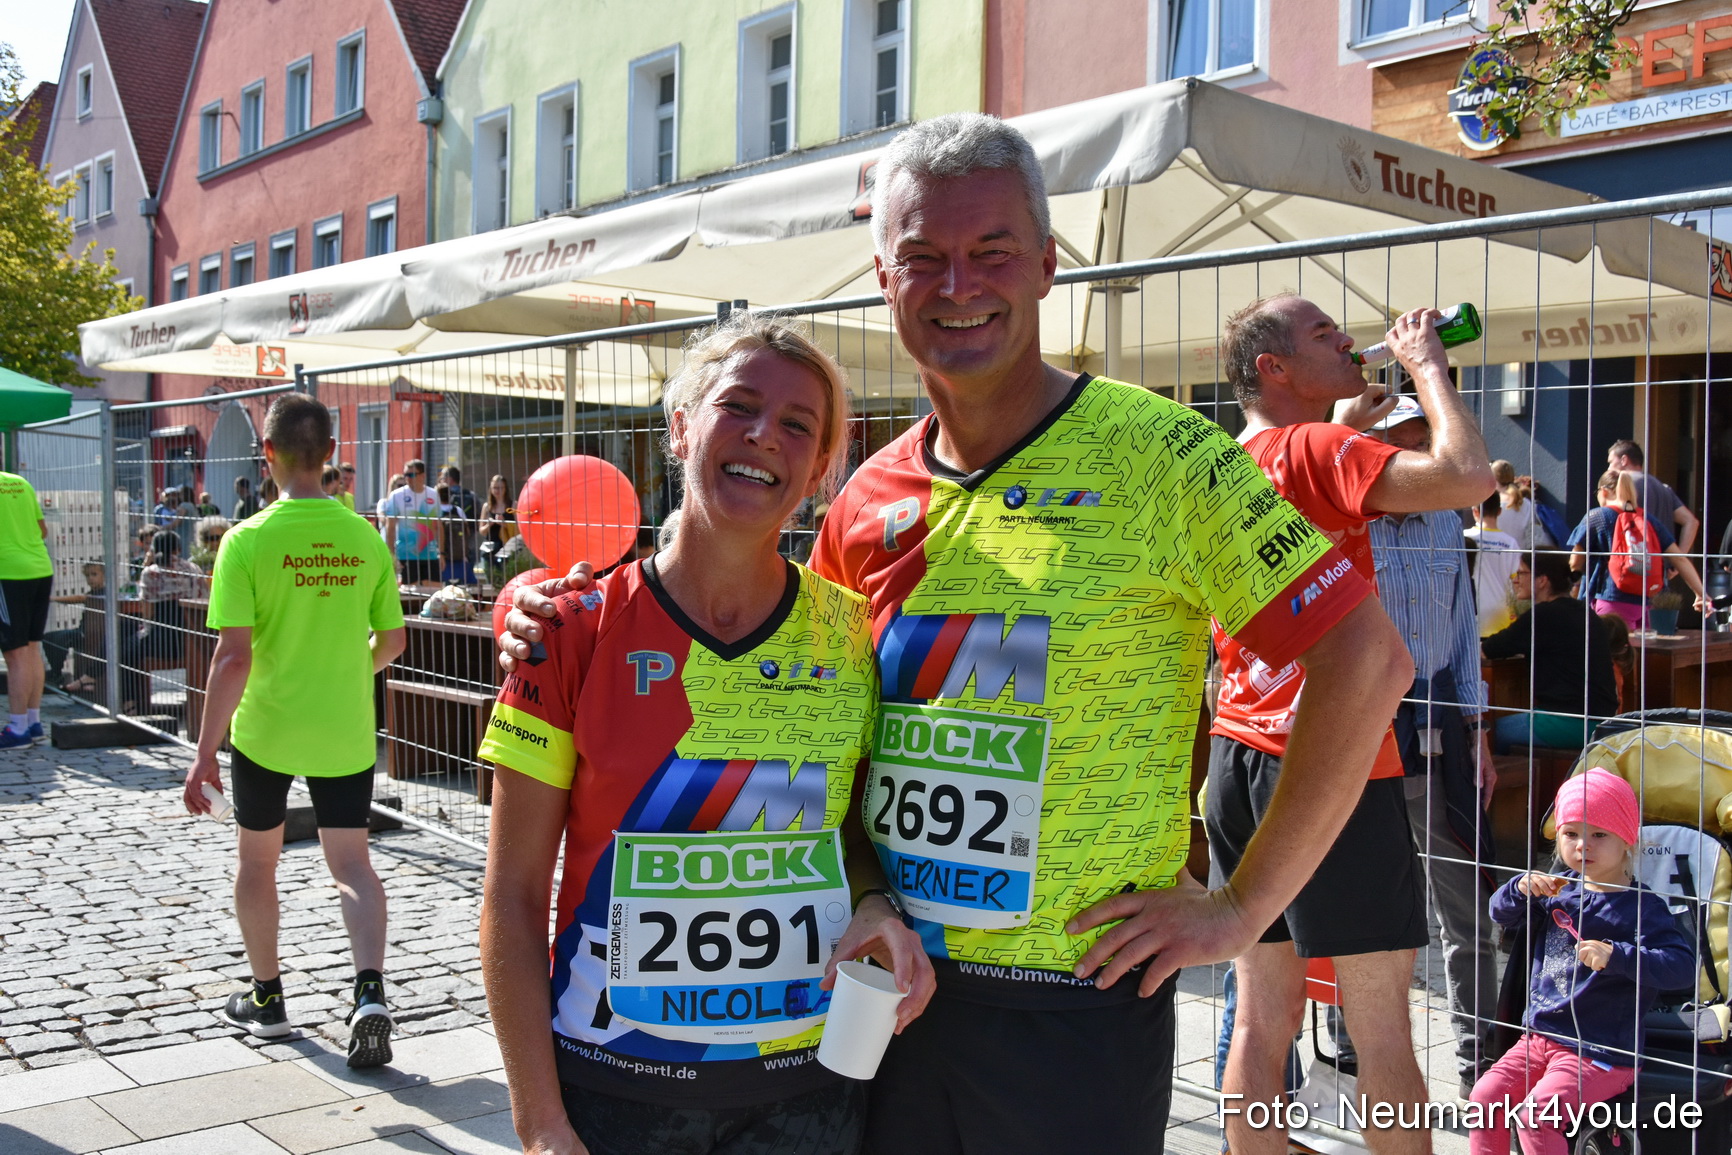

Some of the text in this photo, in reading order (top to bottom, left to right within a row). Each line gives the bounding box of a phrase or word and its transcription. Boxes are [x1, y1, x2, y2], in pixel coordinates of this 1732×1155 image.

[1373, 150, 1496, 218] Tucher
[499, 238, 596, 281] Tucher
[130, 322, 176, 349] Tucher
[1000, 515, 1077, 524] PARTL NEUMARKT
[282, 553, 366, 571] Apotheke-
[295, 572, 358, 587] Dorfner
[317, 589, 331, 597] .de
[561, 594, 583, 616] werk
[881, 713, 1026, 770] BOCK
[873, 775, 1009, 854] 2692
[632, 841, 826, 889] BOCK
[637, 904, 820, 973] 2691
[559, 1039, 697, 1080] www.bmw-partl.de
